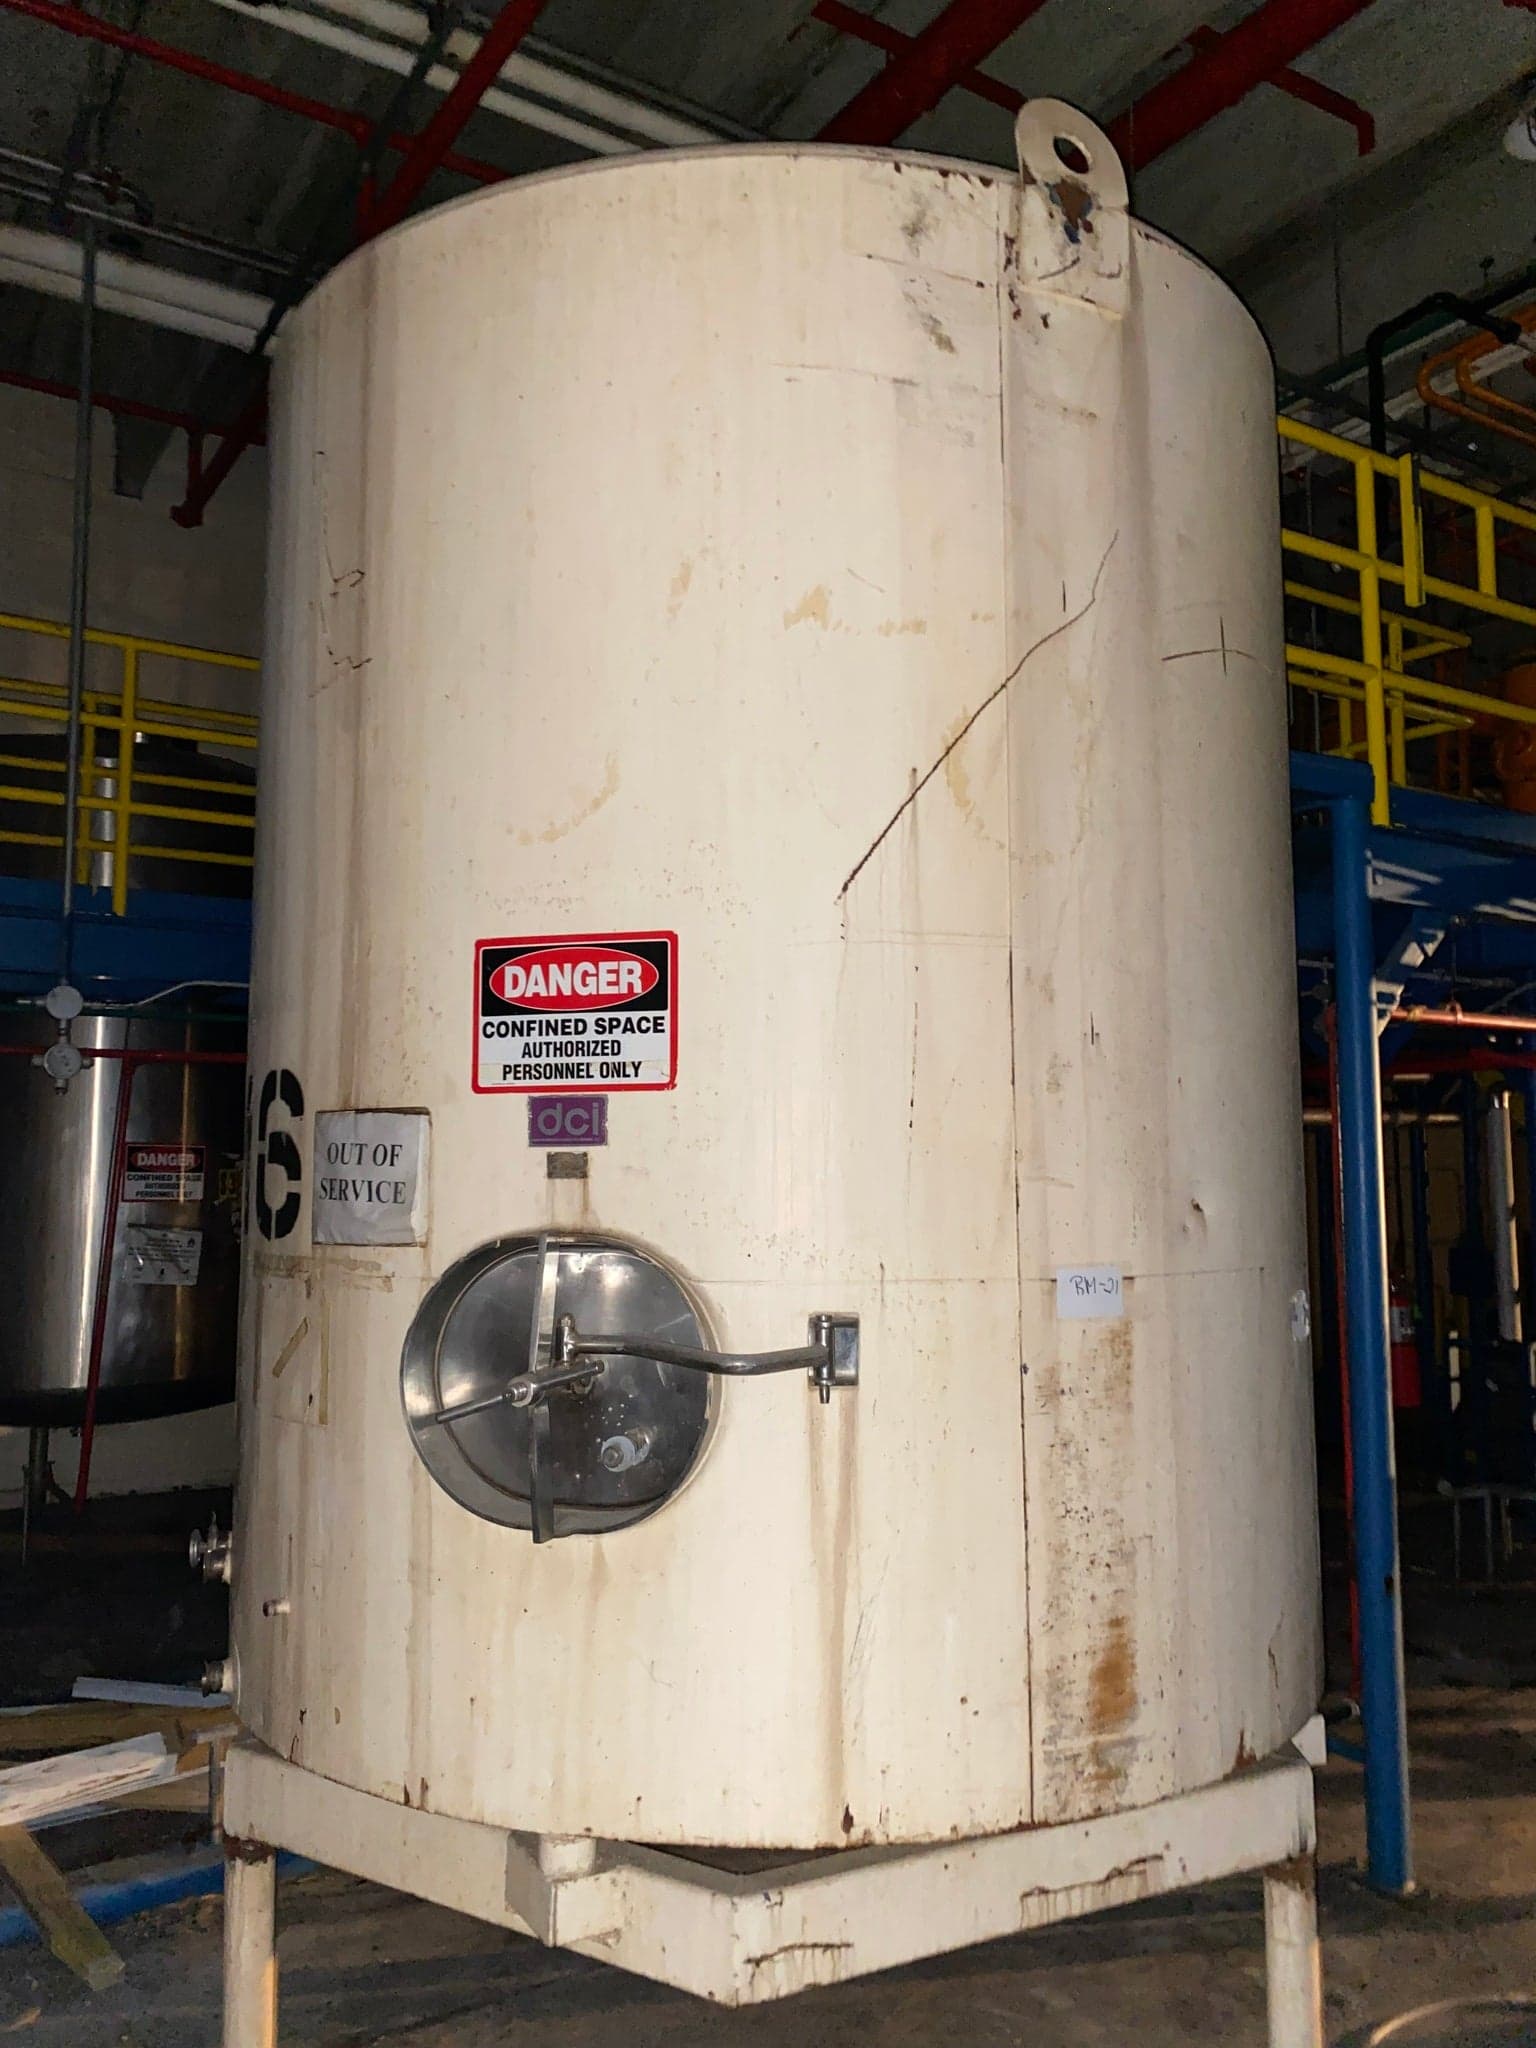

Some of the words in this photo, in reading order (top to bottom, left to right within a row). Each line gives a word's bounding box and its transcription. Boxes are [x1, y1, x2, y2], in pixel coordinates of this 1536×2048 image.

[503, 961, 643, 999] DANGER
[482, 1018, 588, 1039] CONFINED
[594, 1016, 666, 1035] SPACE
[521, 1039, 622, 1059] AUTHORIZED
[502, 1062, 594, 1081] PERSONNEL
[599, 1061, 642, 1079] ONLY
[537, 1102, 599, 1136] dci
[136, 1152, 195, 1167] DANGER
[326, 1142, 368, 1165] OUT
[372, 1143, 403, 1168] OF
[319, 1177, 407, 1205] SERVICE
